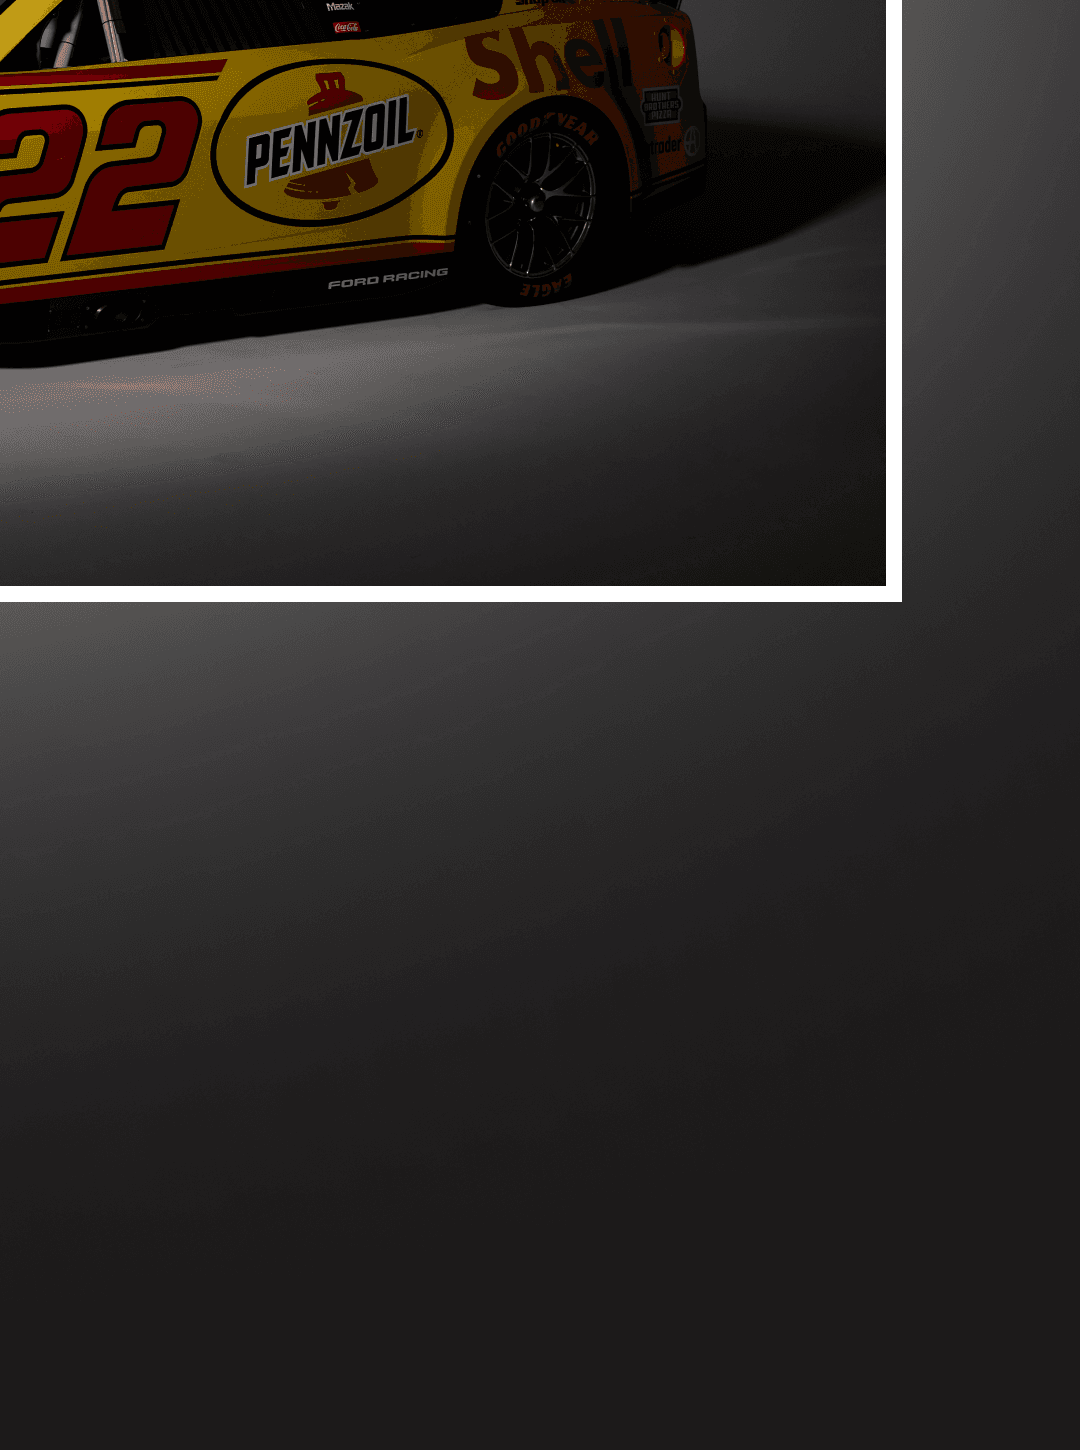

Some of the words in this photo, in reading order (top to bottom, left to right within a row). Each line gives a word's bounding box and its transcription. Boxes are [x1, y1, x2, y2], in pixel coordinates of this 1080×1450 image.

[325, 2, 355, 11] Mazak
[464, 17, 633, 100] Shell
[644, 101, 679, 111] BROTHERS
[651, 92, 672, 102] HUNT
[651, 110, 672, 120] PIZZA
[244, 94, 417, 188] PENNZOIL
[650, 136, 682, 155] trader
[327, 276, 379, 291] FORD
[382, 268, 449, 285] RACING
[520, 273, 572, 298] EAGLE
